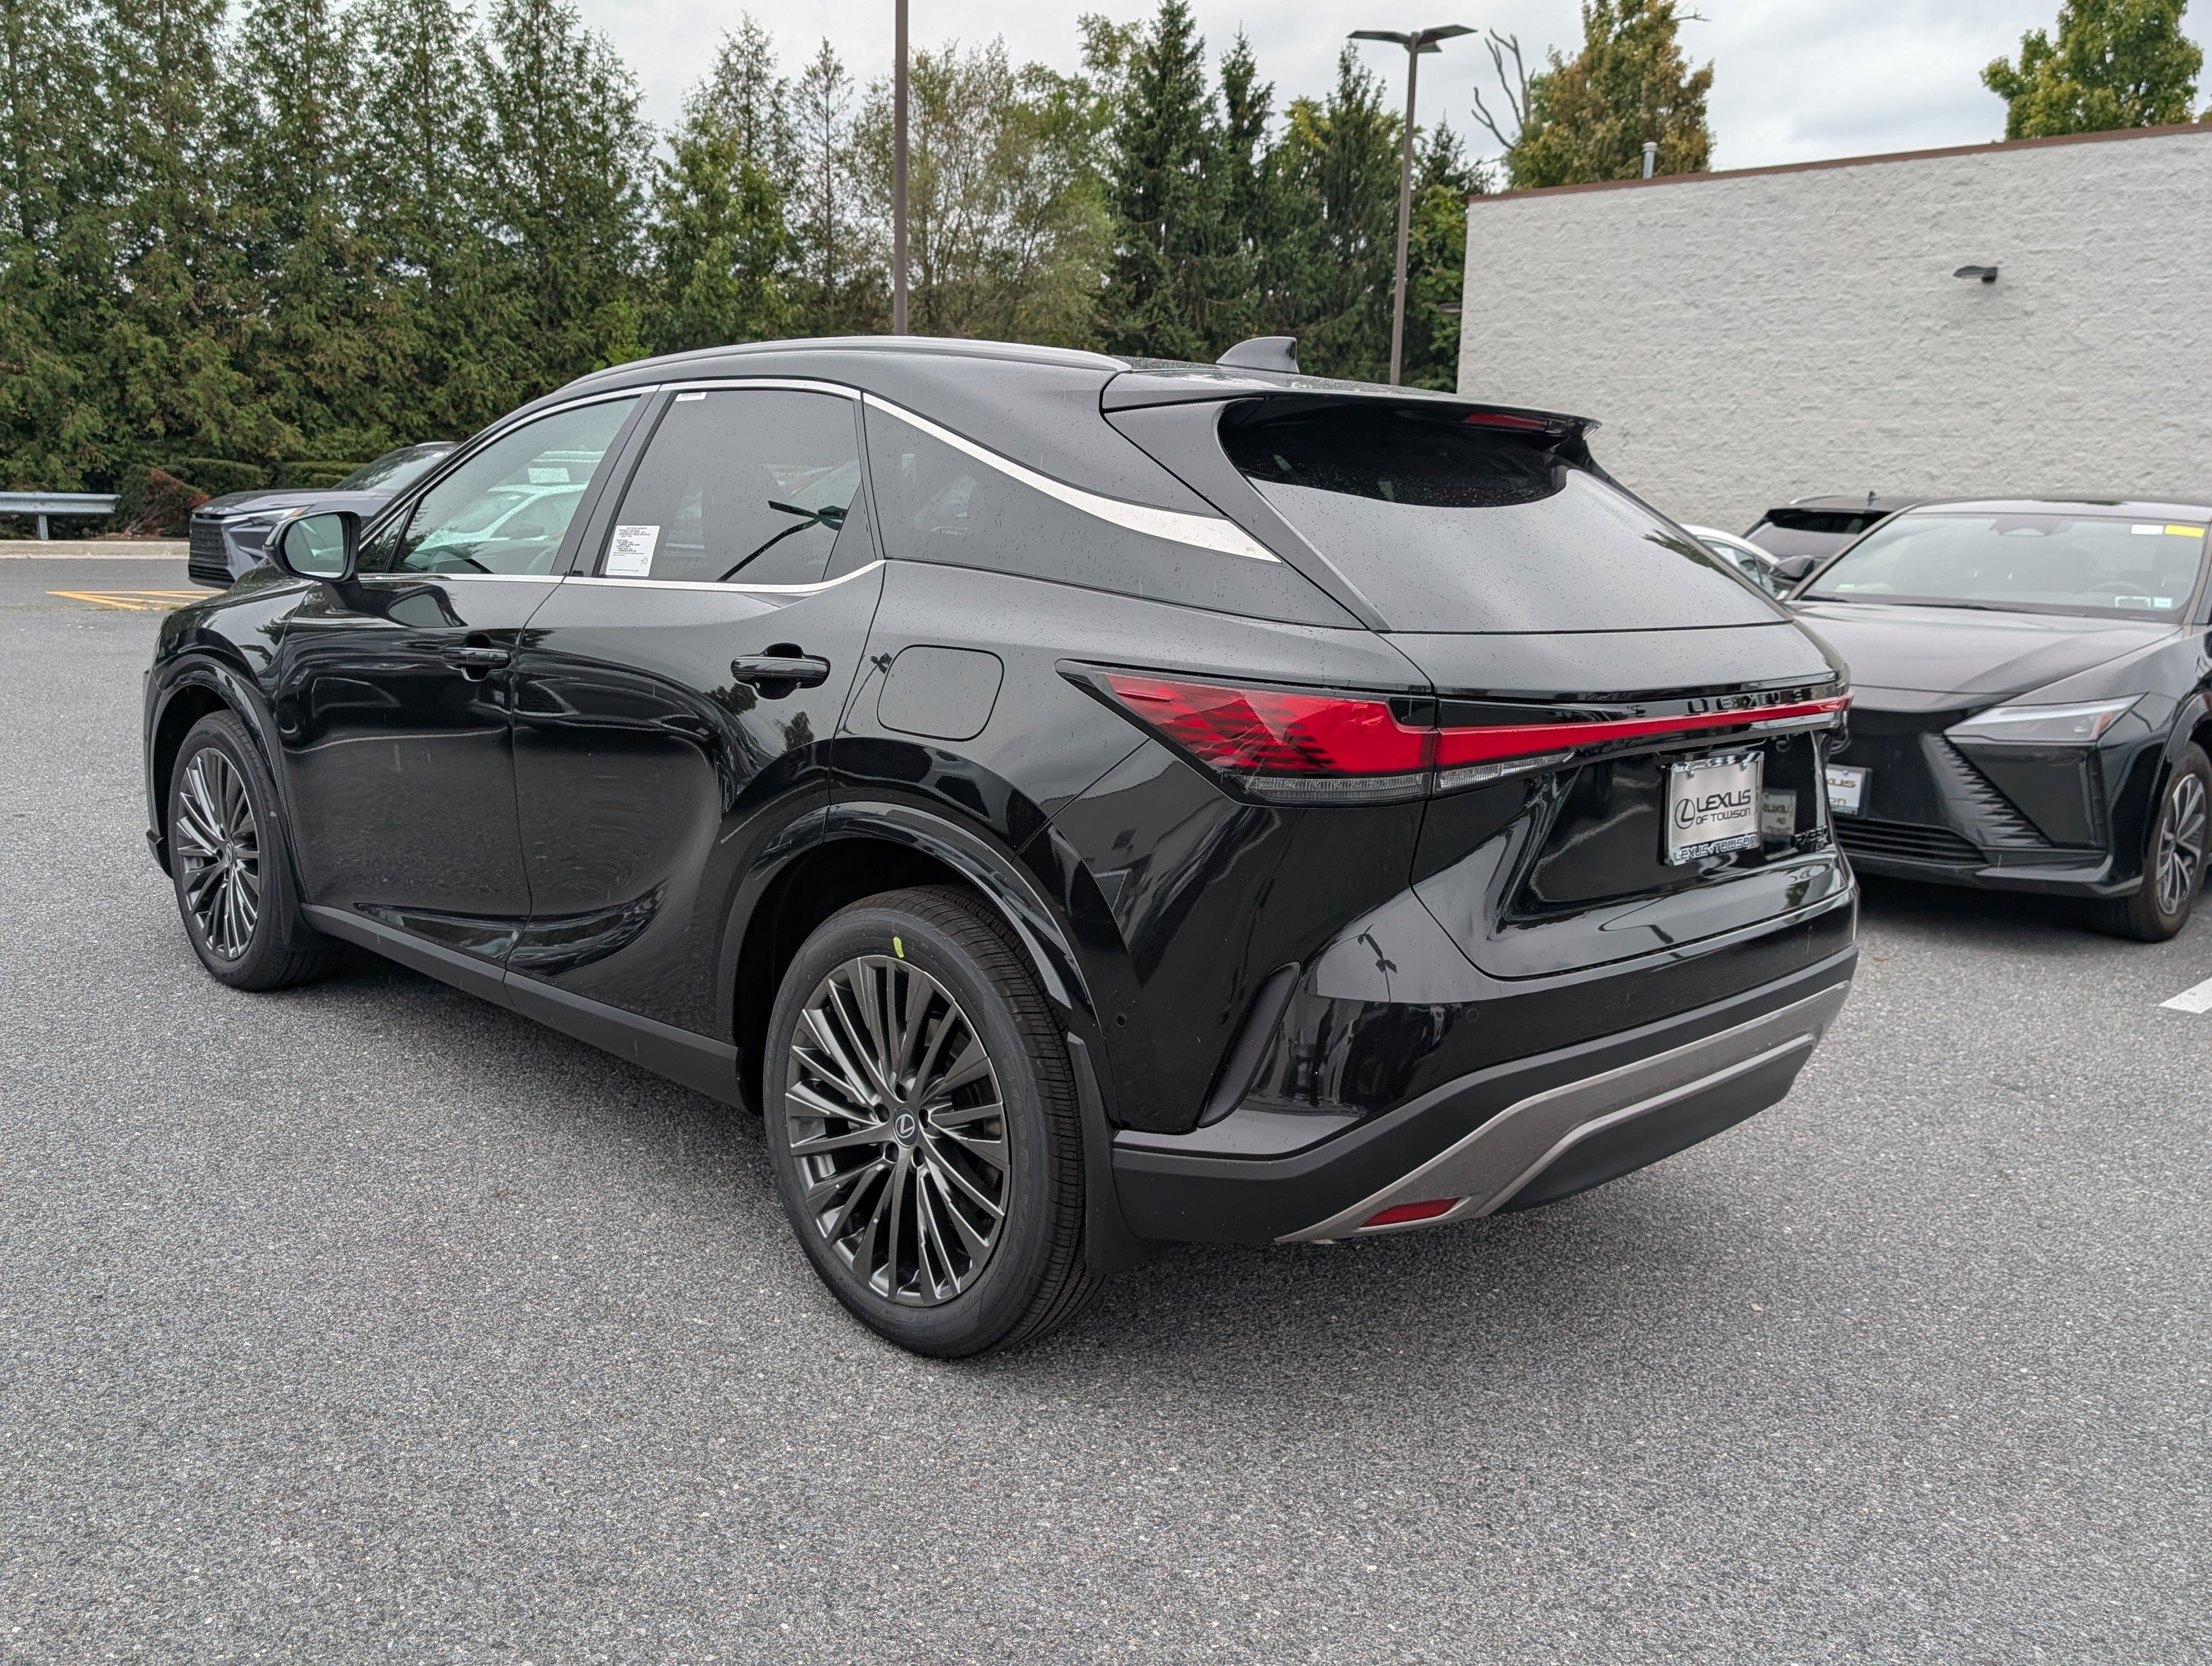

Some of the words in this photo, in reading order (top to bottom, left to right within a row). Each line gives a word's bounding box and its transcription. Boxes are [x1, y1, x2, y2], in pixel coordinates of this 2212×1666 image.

[1687, 689, 1803, 713] LEXUS
[1696, 789, 1751, 813] LEXUS
[1696, 815, 1709, 825] OF
[1673, 843, 1709, 861] LEXUS
